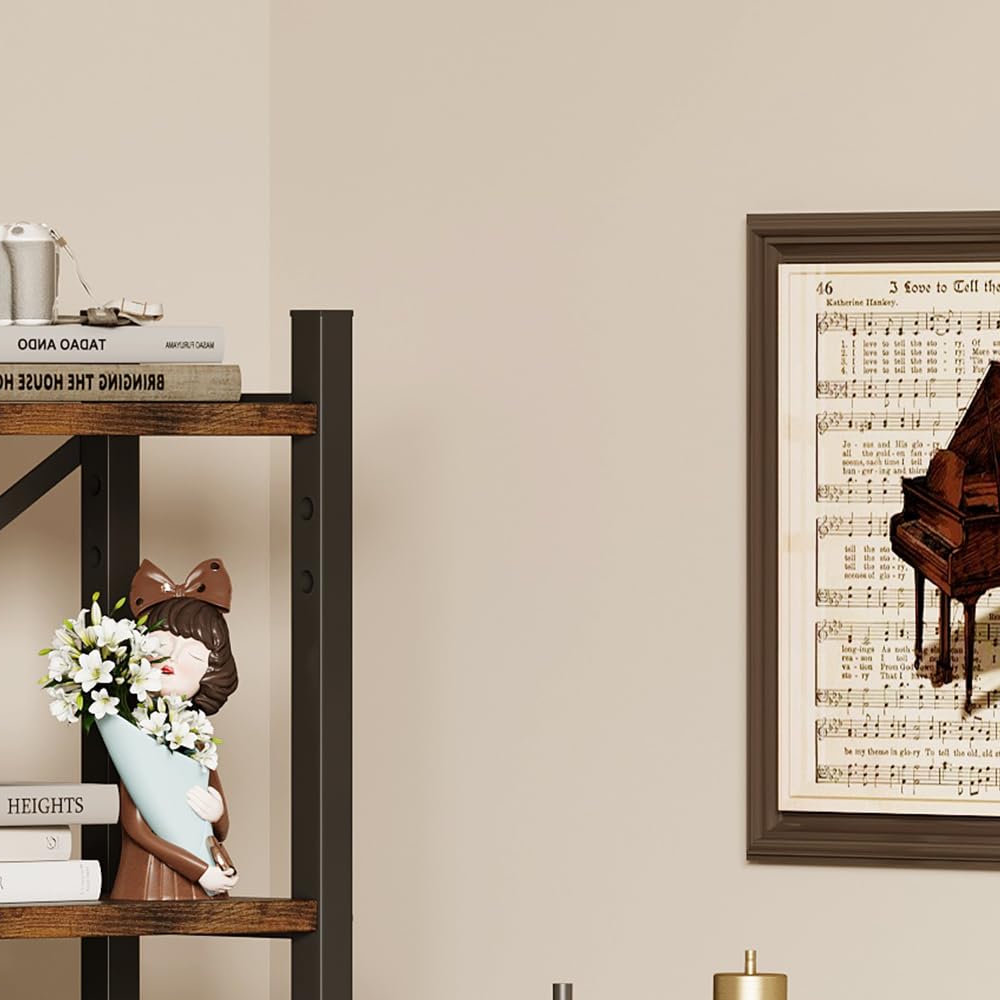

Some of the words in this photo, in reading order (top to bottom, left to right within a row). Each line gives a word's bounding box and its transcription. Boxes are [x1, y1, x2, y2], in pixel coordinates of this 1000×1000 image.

[816, 280, 833, 295] 46
[904, 280, 931, 293] Love
[937, 281, 948, 293] to
[953, 280, 978, 293] Tell
[826, 298, 863, 306] Katherine
[7, 797, 84, 815] HEIGHTS
